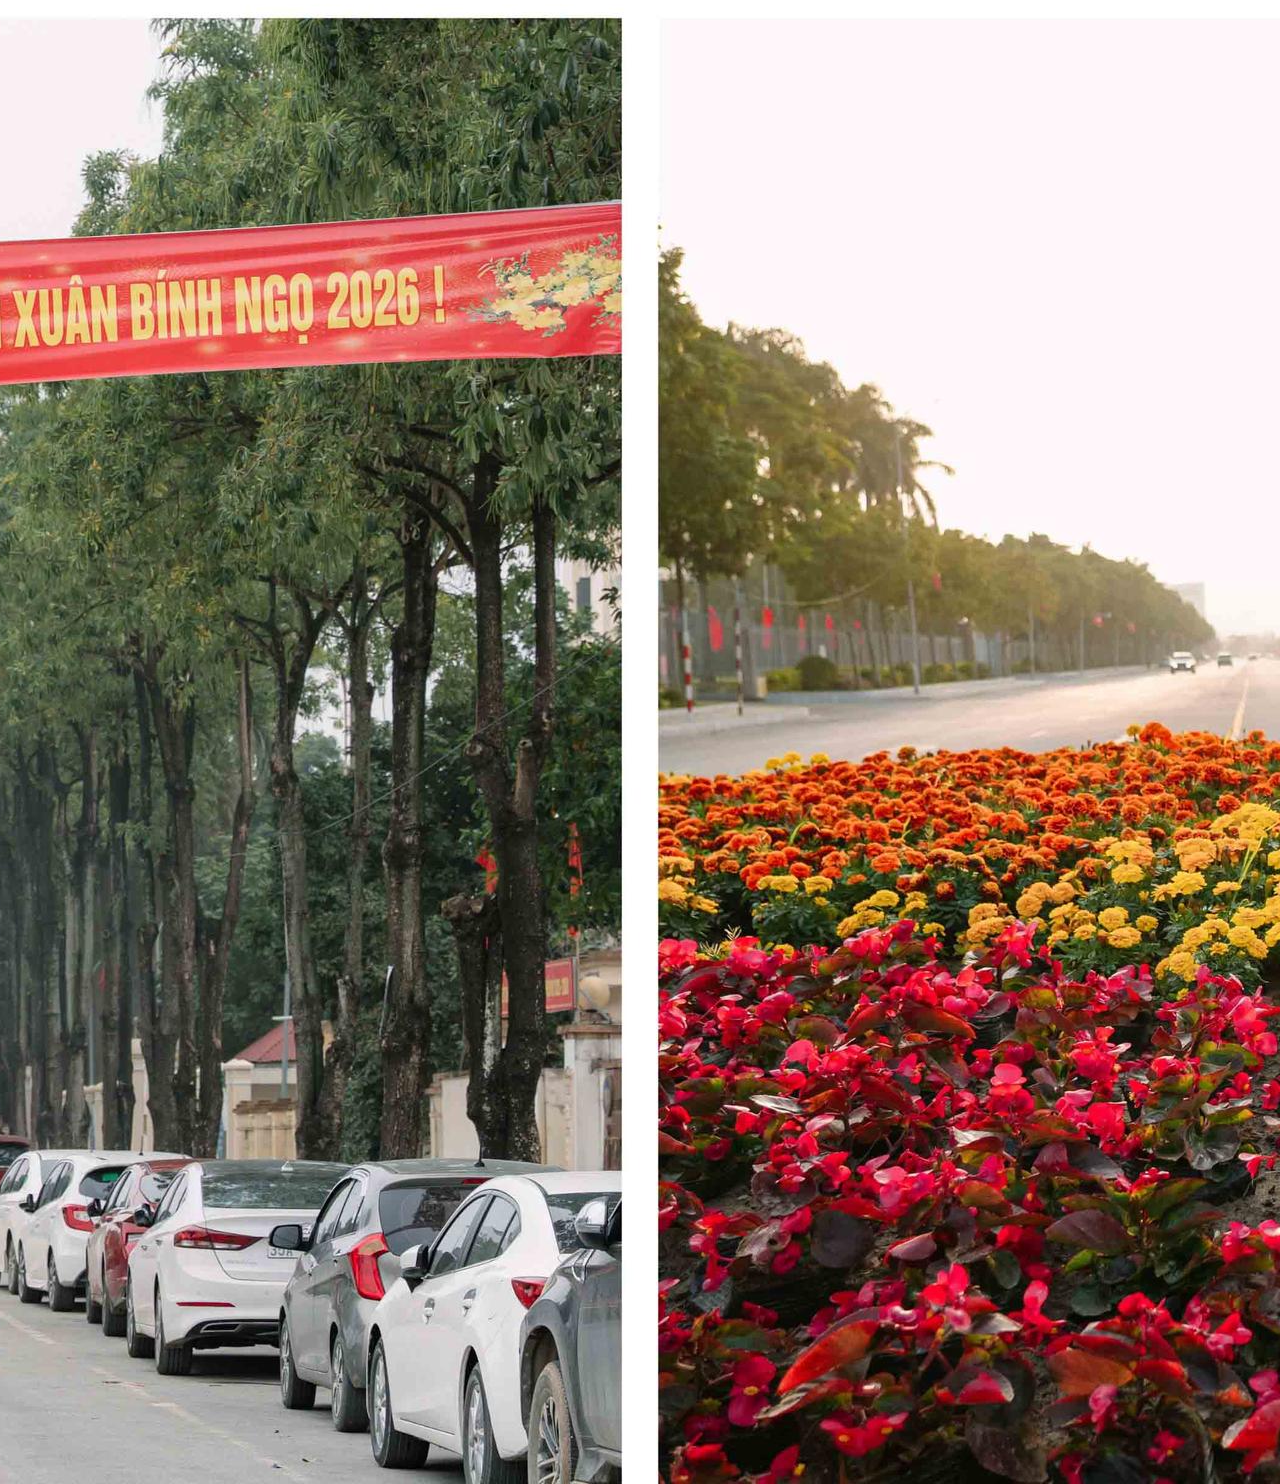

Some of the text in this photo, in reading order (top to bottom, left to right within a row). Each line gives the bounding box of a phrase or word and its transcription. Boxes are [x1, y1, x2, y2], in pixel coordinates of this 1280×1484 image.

[12, 275, 113, 347] XUÂN
[130, 269, 221, 341] BÍNH
[234, 272, 315, 345] NGỌ
[326, 266, 420, 328] 2026
[432, 264, 446, 324] !
